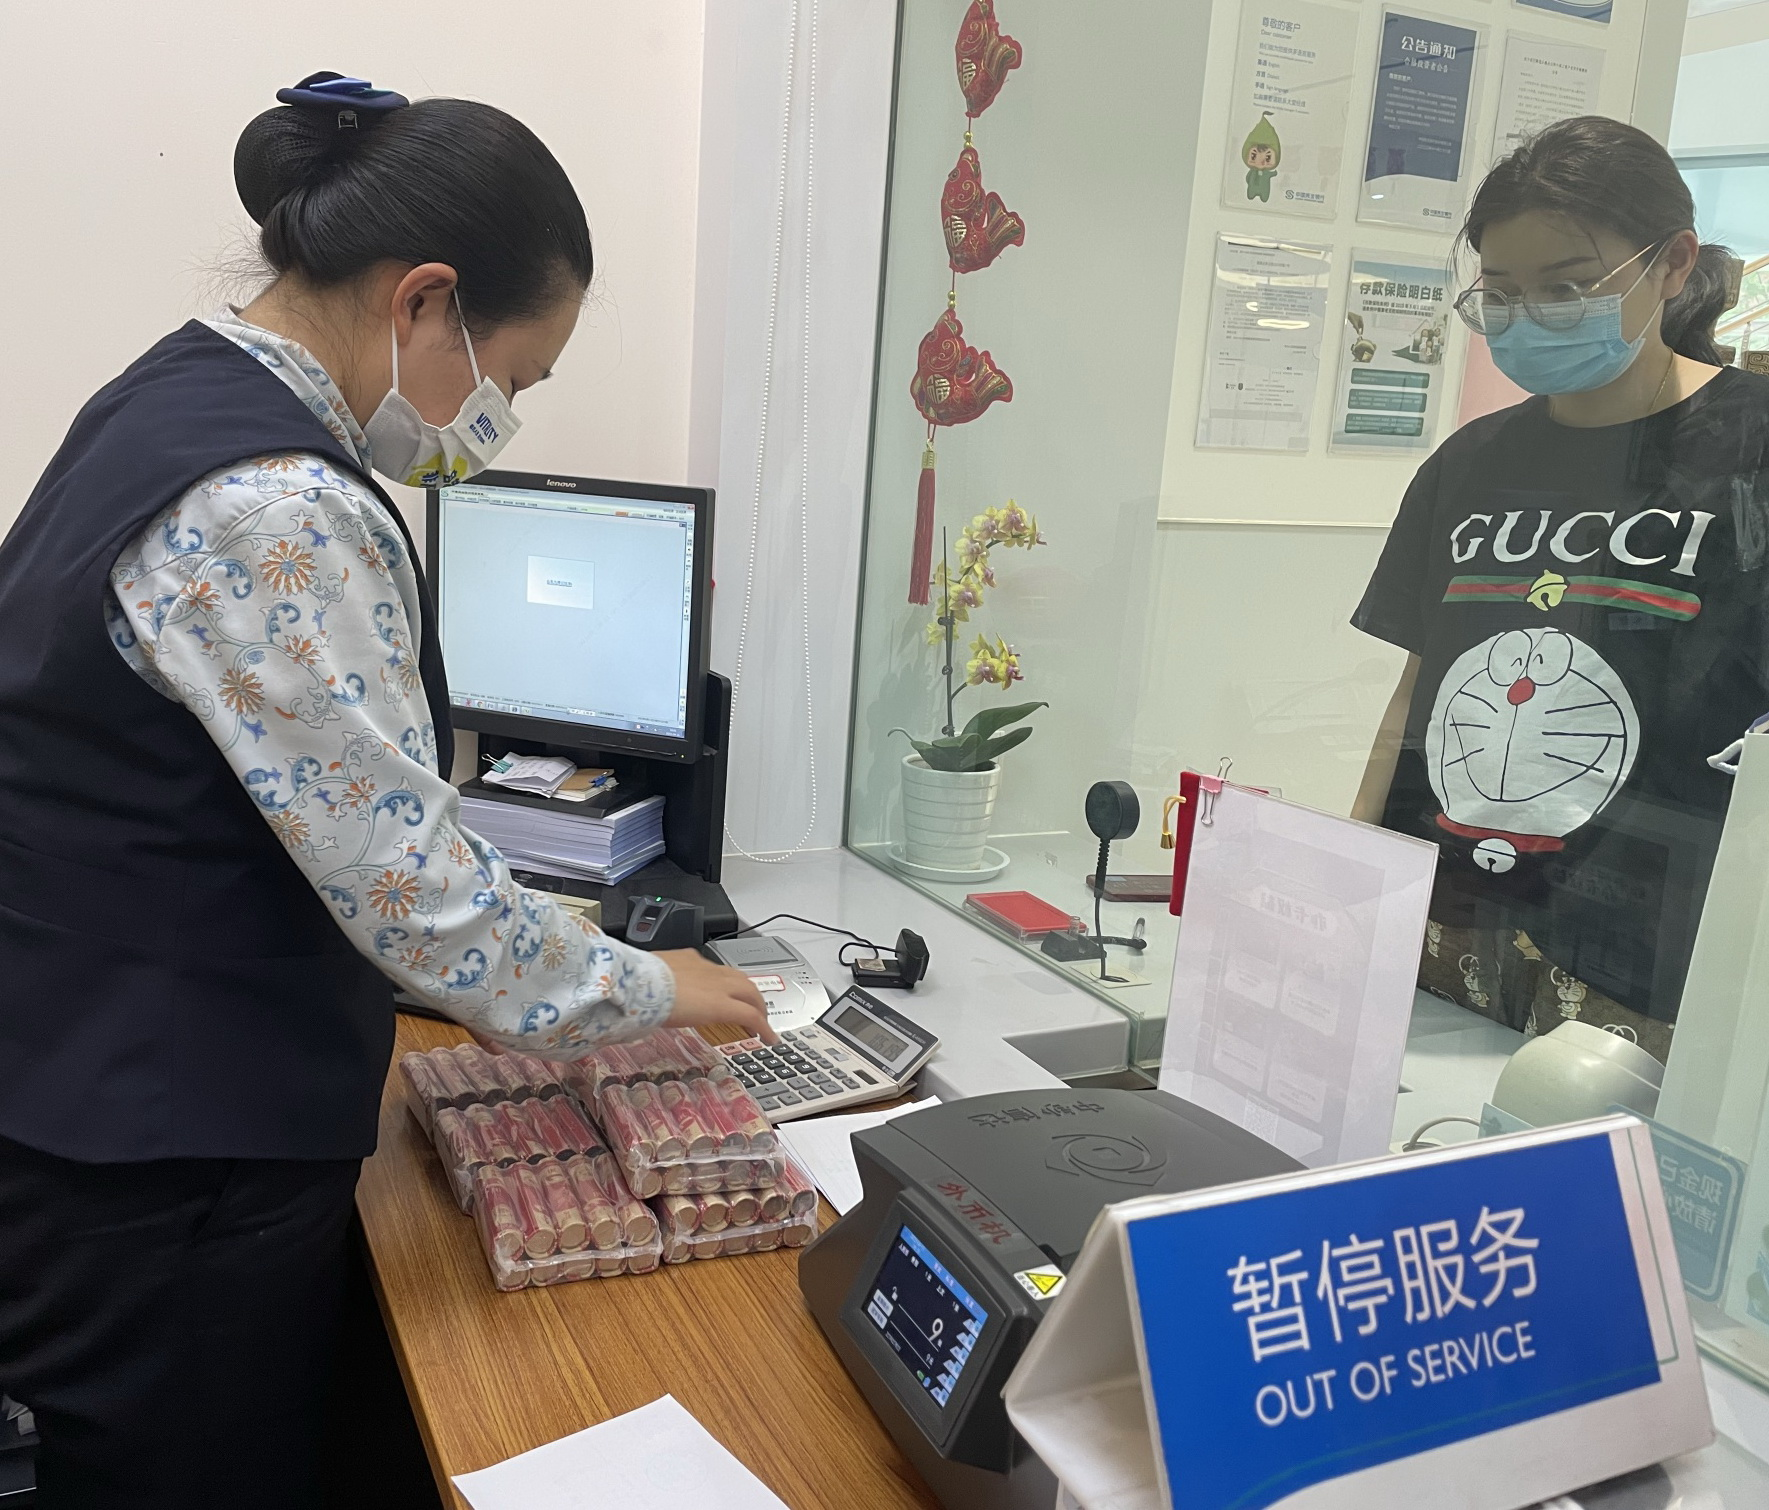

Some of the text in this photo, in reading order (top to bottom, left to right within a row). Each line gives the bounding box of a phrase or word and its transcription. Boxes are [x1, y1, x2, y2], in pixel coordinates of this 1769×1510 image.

[1401, 35, 1457, 60] 公告通知
[1359, 281, 1444, 302] 存款保险明白纸
[1450, 508, 1717, 577] GUCCI
[1226, 1206, 1540, 1362] 暂停服务
[1255, 1321, 1537, 1427] OUT OF SERVICE
